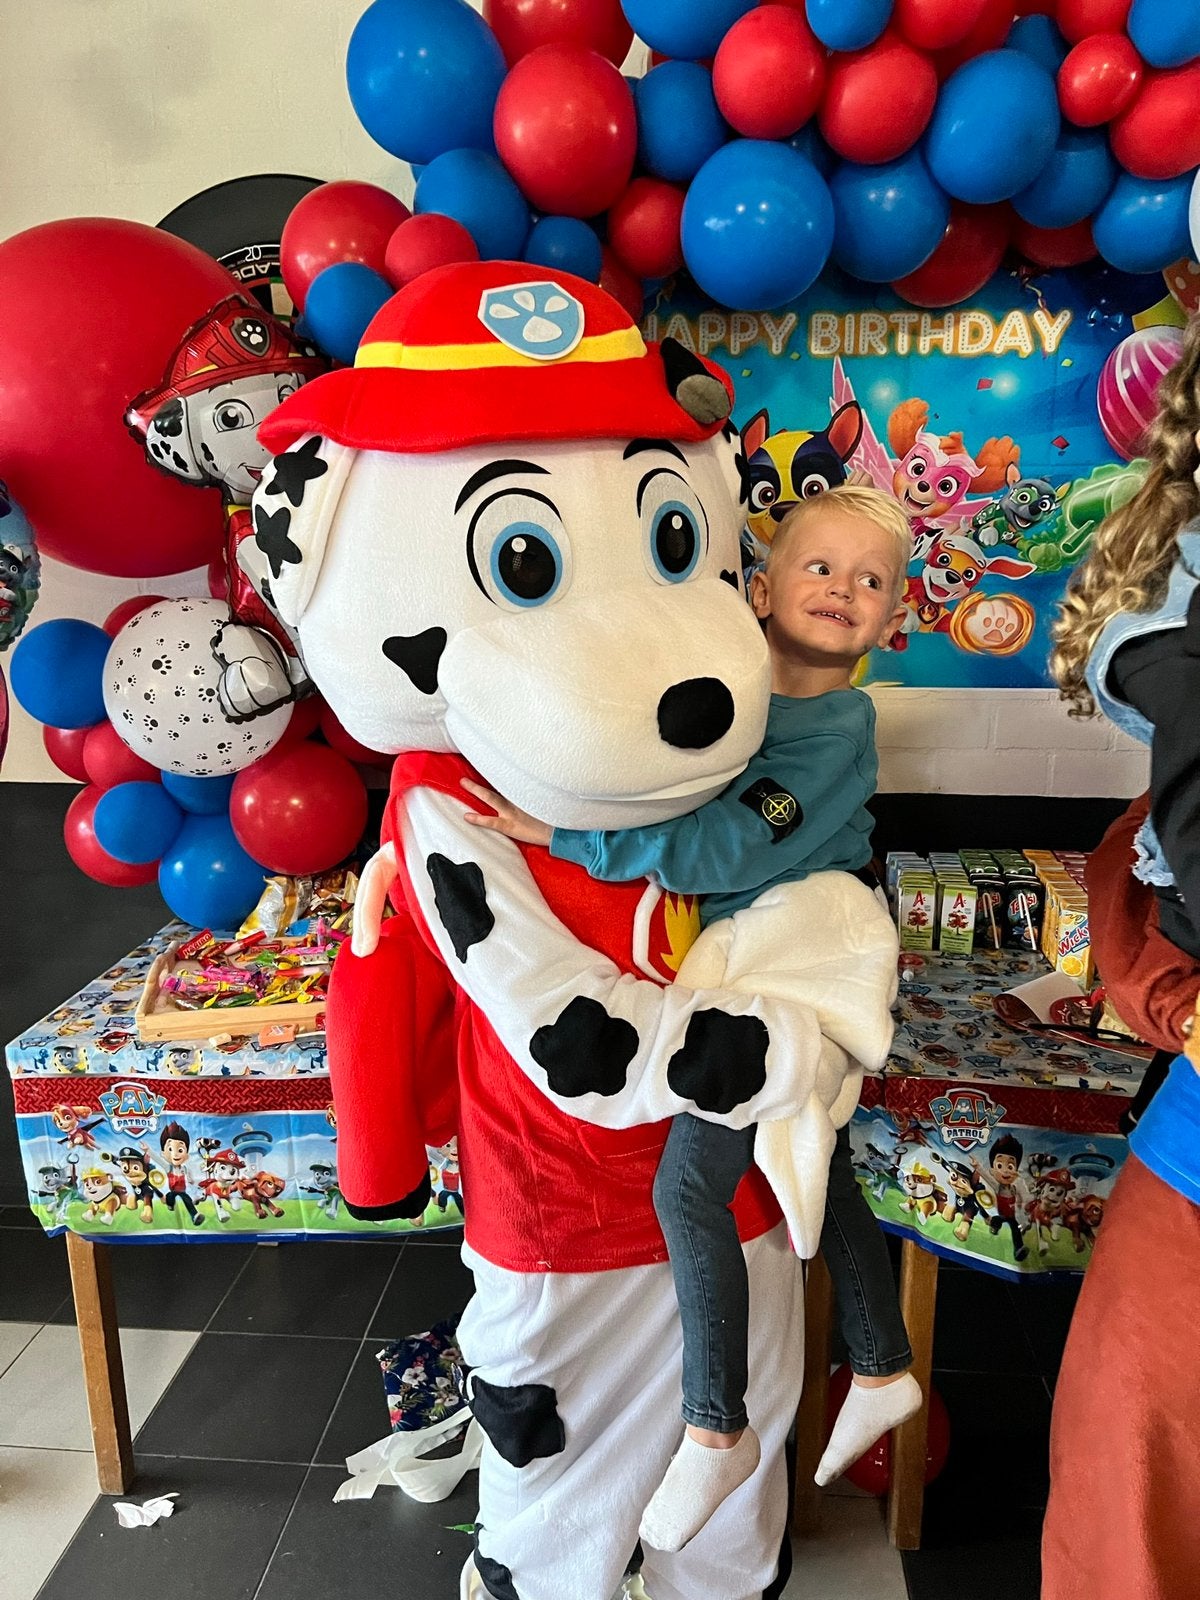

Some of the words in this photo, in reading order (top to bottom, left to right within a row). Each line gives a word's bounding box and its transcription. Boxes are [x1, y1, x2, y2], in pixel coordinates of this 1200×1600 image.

[245, 245, 261, 262] 20
[811, 310, 1071, 356] BIRTHDAY
[98, 1089, 168, 1117] PAW
[929, 1096, 1007, 1127] PAW
[116, 1117, 154, 1128] PATROL
[946, 1128, 985, 1140] PATROL
